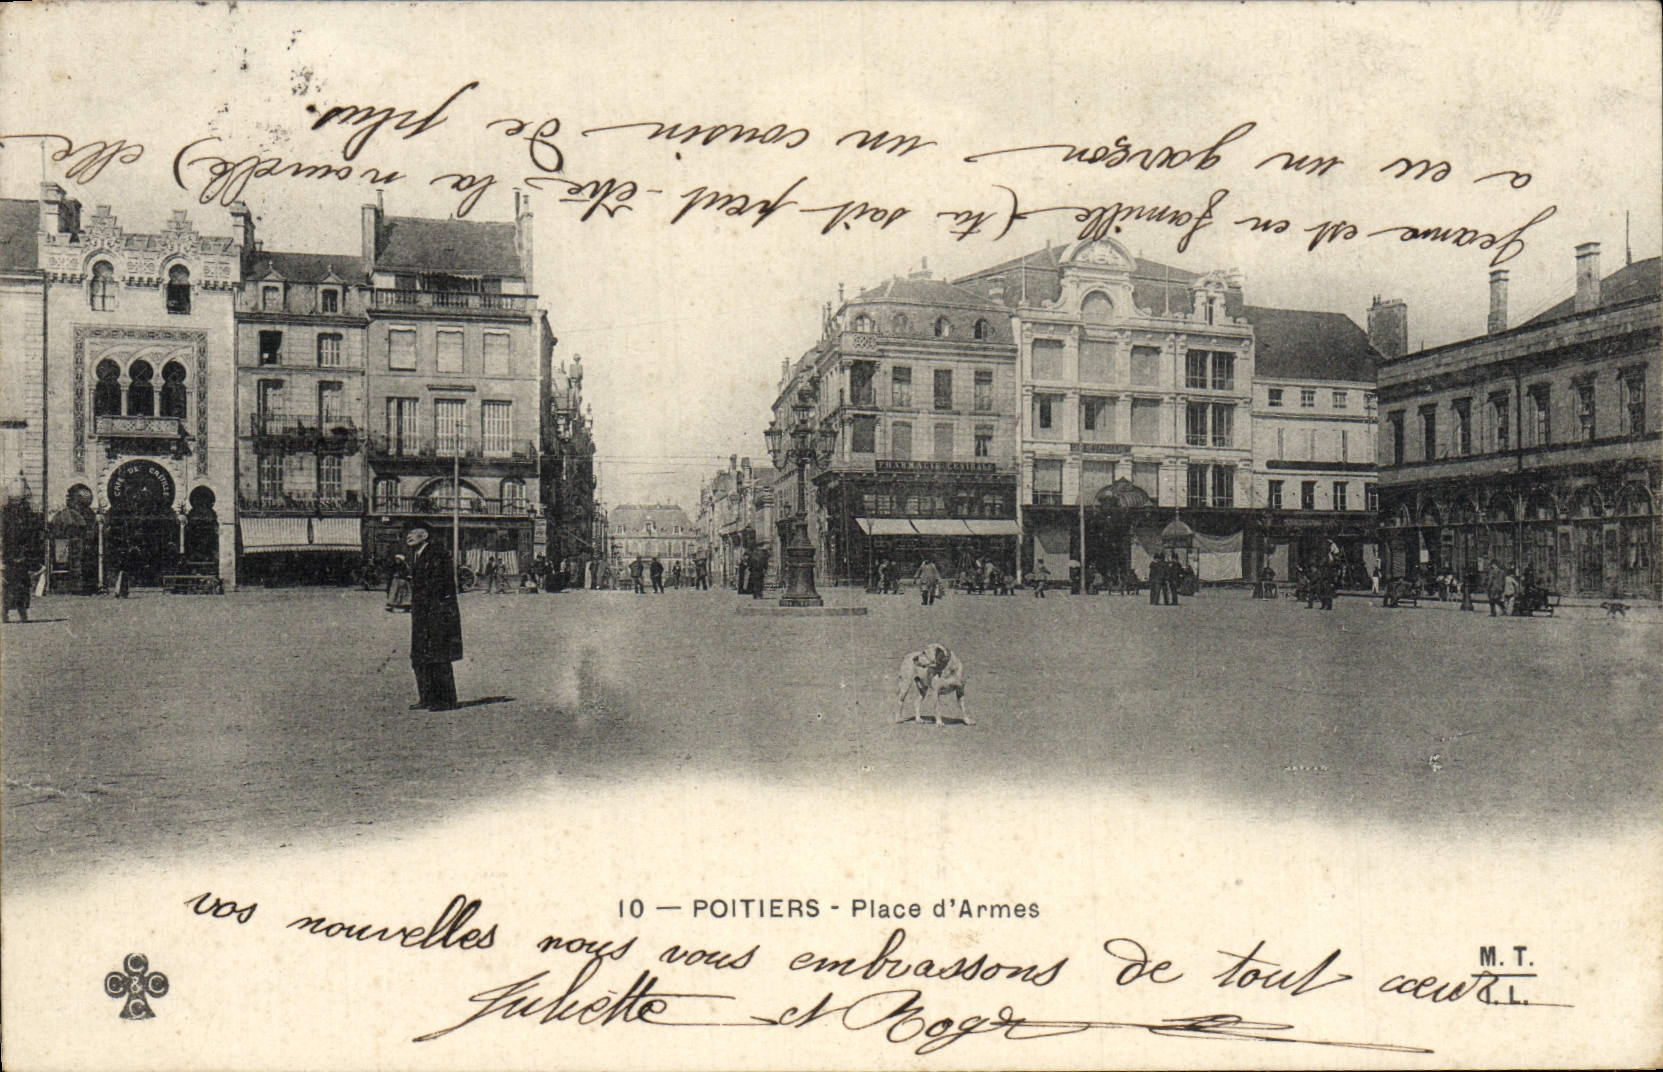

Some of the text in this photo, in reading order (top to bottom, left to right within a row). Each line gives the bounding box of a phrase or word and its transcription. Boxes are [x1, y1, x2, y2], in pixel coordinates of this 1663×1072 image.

[10, 134, 145, 185] elle
[486, 117, 565, 174] de
[598, 120, 811, 161] cousin
[836, 129, 938, 157] un
[990, 121, 1258, 171] garçon
[1254, 151, 1346, 176] un
[1380, 156, 1452, 181] eu
[1473, 169, 1533, 190] a
[430, 174, 498, 218] la
[1022, 188, 1230, 252] famille
[1233, 214, 1290, 234] en
[1304, 223, 1360, 252] est
[184, 891, 258, 925] vos
[286, 893, 497, 950] nouvelles
[537, 935, 638, 961] nous
[659, 944, 761, 970] vous
[789, 928, 1069, 987] embrassons
[1102, 937, 1184, 986] de
[1216, 939, 1352, 997] tout
